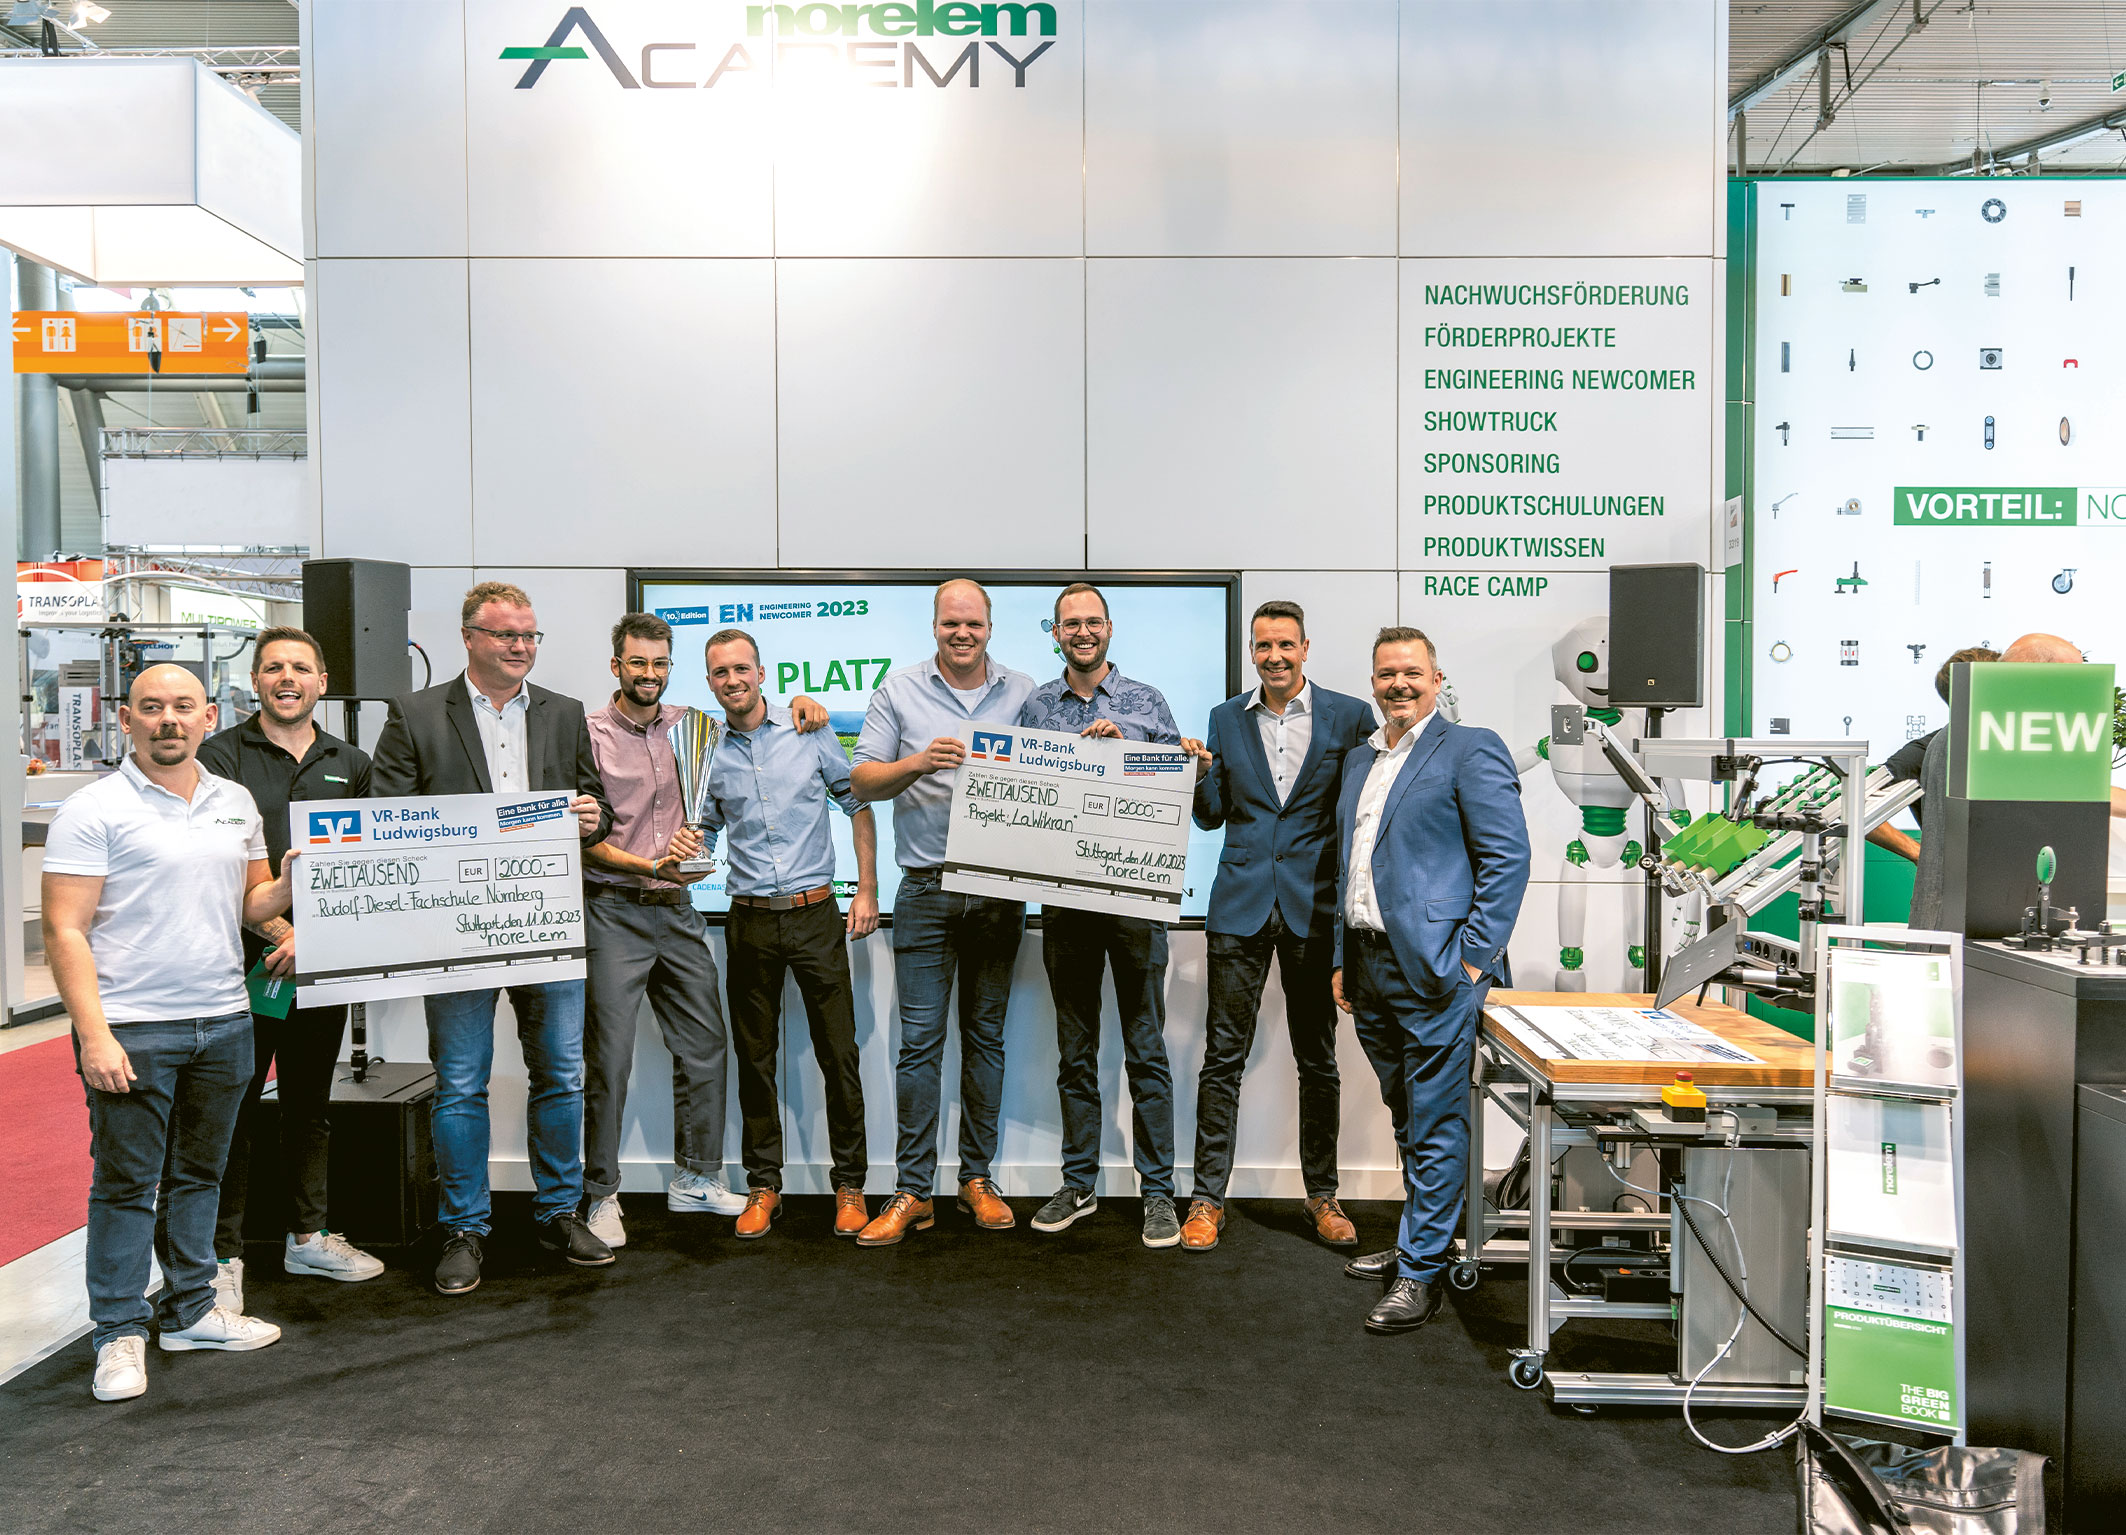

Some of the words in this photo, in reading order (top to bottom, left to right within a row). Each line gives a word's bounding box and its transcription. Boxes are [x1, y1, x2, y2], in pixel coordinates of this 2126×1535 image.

[747, 0, 1057, 36] norelem
[1425, 281, 1689, 306] NACHWUCHSFÖRDERUNG
[1425, 323, 1616, 347] FÖRDERPROJEKTE
[1425, 369, 1564, 390] ENGINEERING
[1572, 370, 1695, 390] NEWCOMER
[1424, 411, 1557, 431] SHOWTRUCK
[1424, 453, 1560, 473] SPONSORING
[1424, 495, 1664, 516] PRODUKTSCHULUNGEN
[1906, 493, 2063, 520] VORTEIL:
[1424, 537, 1605, 557] PRODUKTWISSEN
[1424, 576, 1479, 596] RACE
[1487, 576, 1548, 596] CAMP
[29, 595, 102, 608] TRANSOPLA
[759, 602, 812, 611] ENGINEERING
[817, 599, 869, 618] 2023
[681, 611, 707, 620] Edition
[719, 603, 754, 623] EN
[759, 610, 812, 620] NEWCOMER
[1979, 711, 2108, 752] NEW
[1020, 737, 1076, 755] VR-Bank
[1019, 752, 1106, 777] Ludwigsburg
[1125, 754, 1141, 762] Eine
[1141, 754, 1160, 762] Bank
[1161, 754, 1173, 762] für
[988, 773, 999, 781] Sie
[999, 775, 1018, 785] gegen
[1039, 780, 1060, 789] Scheck
[965, 777, 1059, 807] ZWEITAUSEND
[371, 806, 440, 823] VR-Bank
[498, 808, 516, 817] Eine
[516, 803, 537, 814] Bank
[538, 801, 550, 810] für
[1087, 801, 1105, 811] EUR
[373, 823, 478, 842] Ludwigsburg
[309, 859, 336, 868] Zahlen
[339, 858, 350, 866] Sie
[351, 857, 375, 867] gegen
[402, 854, 428, 862] Scheck
[310, 861, 420, 890] ZWEITAUSEND
[464, 867, 483, 877] EUR
[1105, 864, 1172, 885] norelem
[486, 882, 544, 911] Nürnberg
[487, 929, 567, 947] norelem
[1884, 1144, 1896, 1193] norelem
[1833, 1310, 1947, 1336] PRODUKTÜBERSICHT
[1900, 1383, 1925, 1397] THE
[1926, 1388, 1950, 1401] BIG
[1901, 1394, 1950, 1411] GREEN
[1901, 1404, 1937, 1419] BOOK
